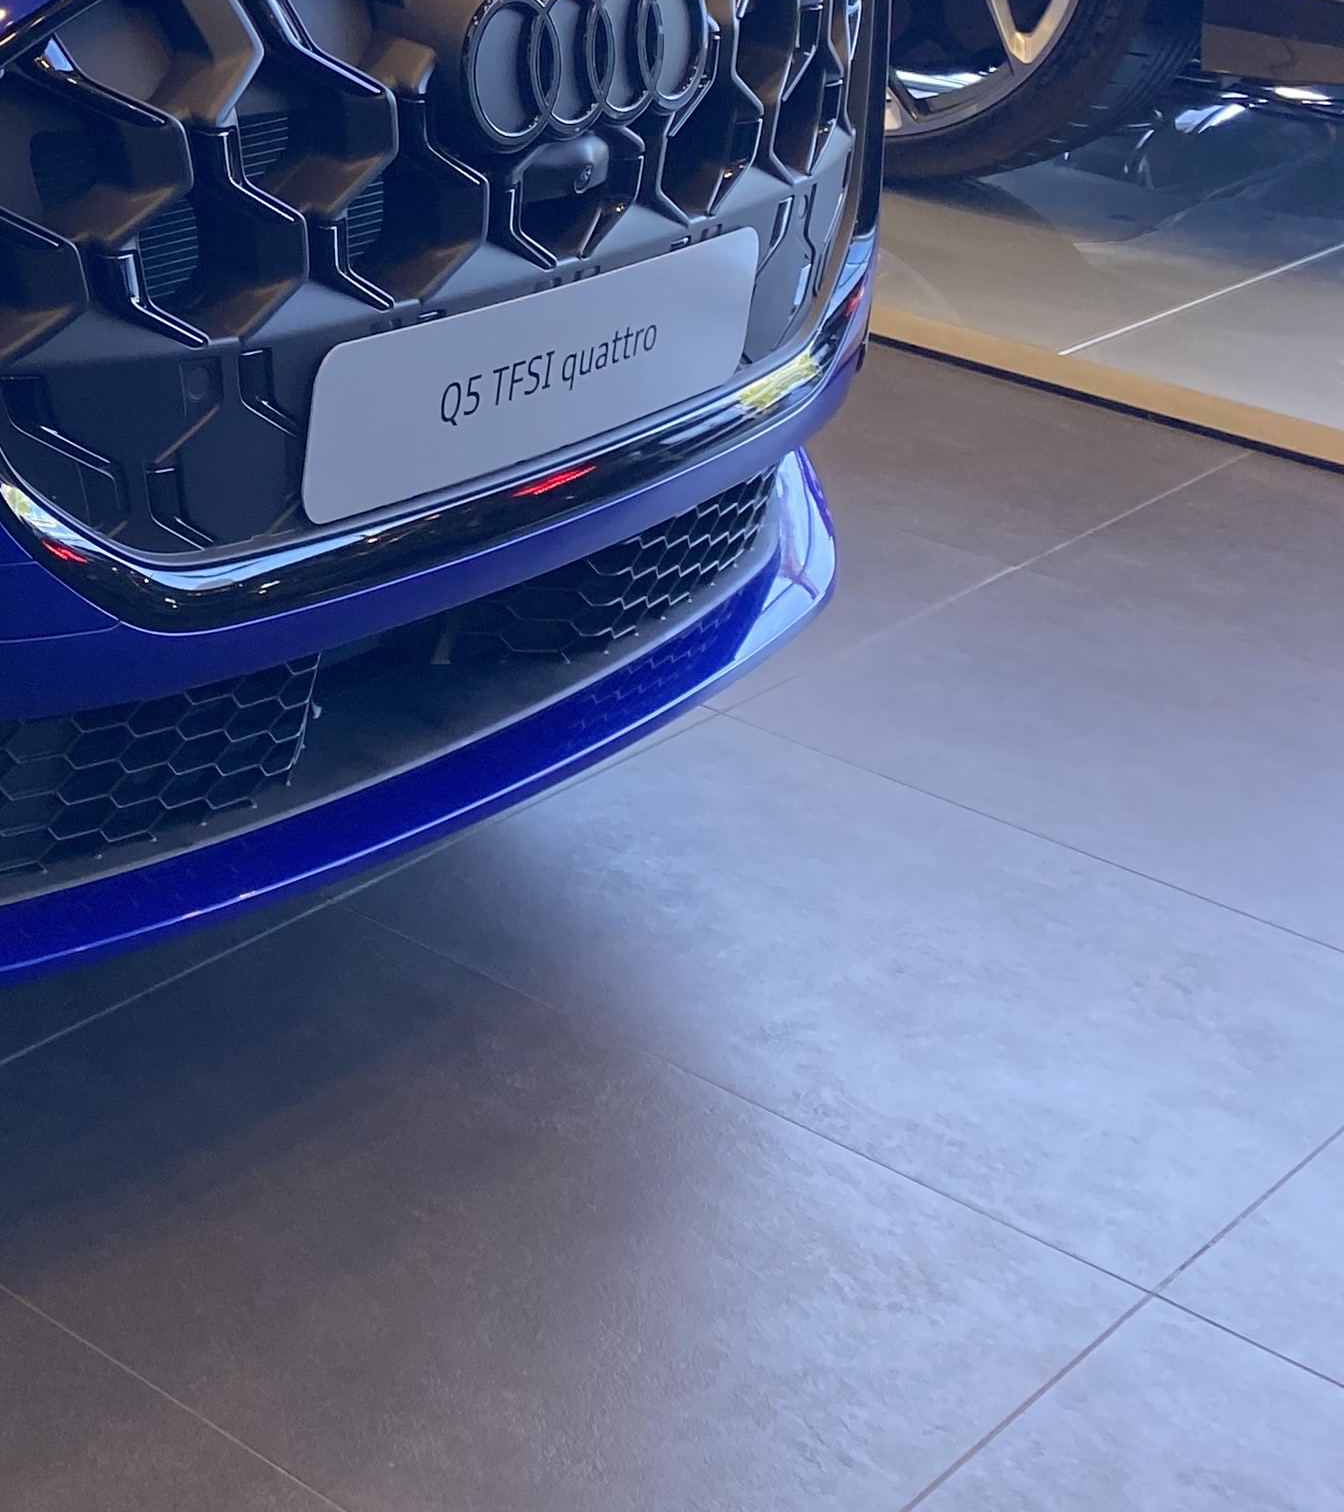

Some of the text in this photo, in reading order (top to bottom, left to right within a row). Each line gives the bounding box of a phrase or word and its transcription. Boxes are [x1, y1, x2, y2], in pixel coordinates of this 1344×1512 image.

[440, 324, 657, 427] Q5 TFSI quattro
